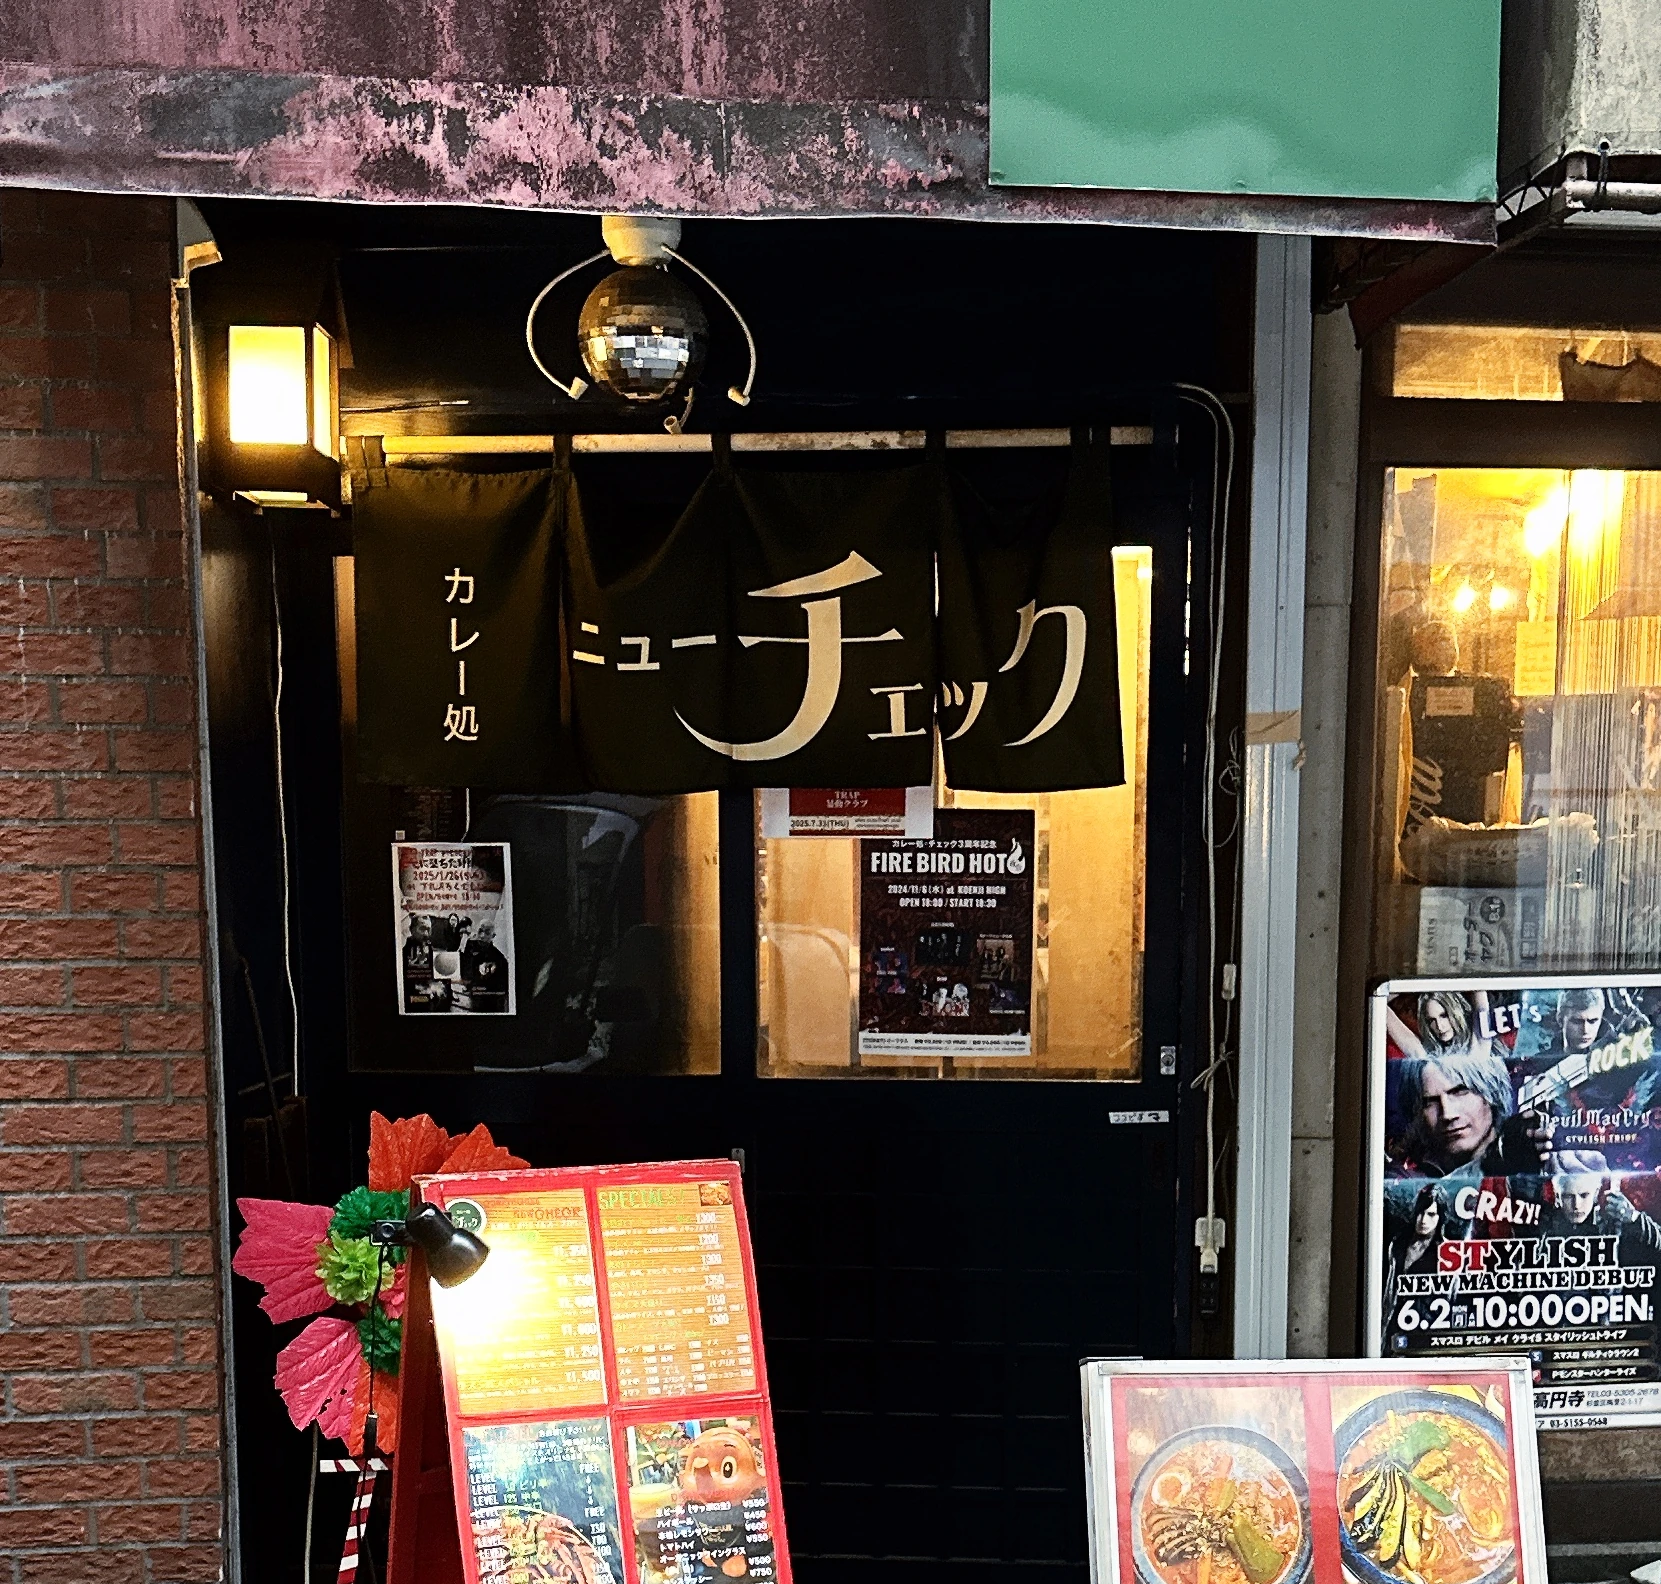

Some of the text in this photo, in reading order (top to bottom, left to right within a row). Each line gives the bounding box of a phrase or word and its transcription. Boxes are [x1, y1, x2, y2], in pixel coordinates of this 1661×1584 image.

[443, 567, 479, 743] カレー処
[871, 852, 1007, 873] FIRE BIRD HOT
[899, 898, 920, 907] OPEN
[1583, 1108, 1621, 1127] May
[1618, 1104, 1651, 1130] Cry
[1455, 1186, 1541, 1225] CRAZY!
[1438, 1236, 1620, 1273] STYLISH
[1397, 1266, 1655, 1295] NEW MACHINE DEBUT
[1397, 1299, 1450, 1331] 6.2
[1473, 1294, 1564, 1327] 10:00
[1565, 1294, 1649, 1325] OPEN
[1431, 1336, 1463, 1346] スマスロ
[1466, 1335, 1491, 1345] デビル
[1493, 1334, 1508, 1344] メイ
[1533, 1390, 1585, 1408] 高円寺
[473, 1495, 499, 1507] LEVEL
[660, 1540, 695, 1552] トマトハイ
